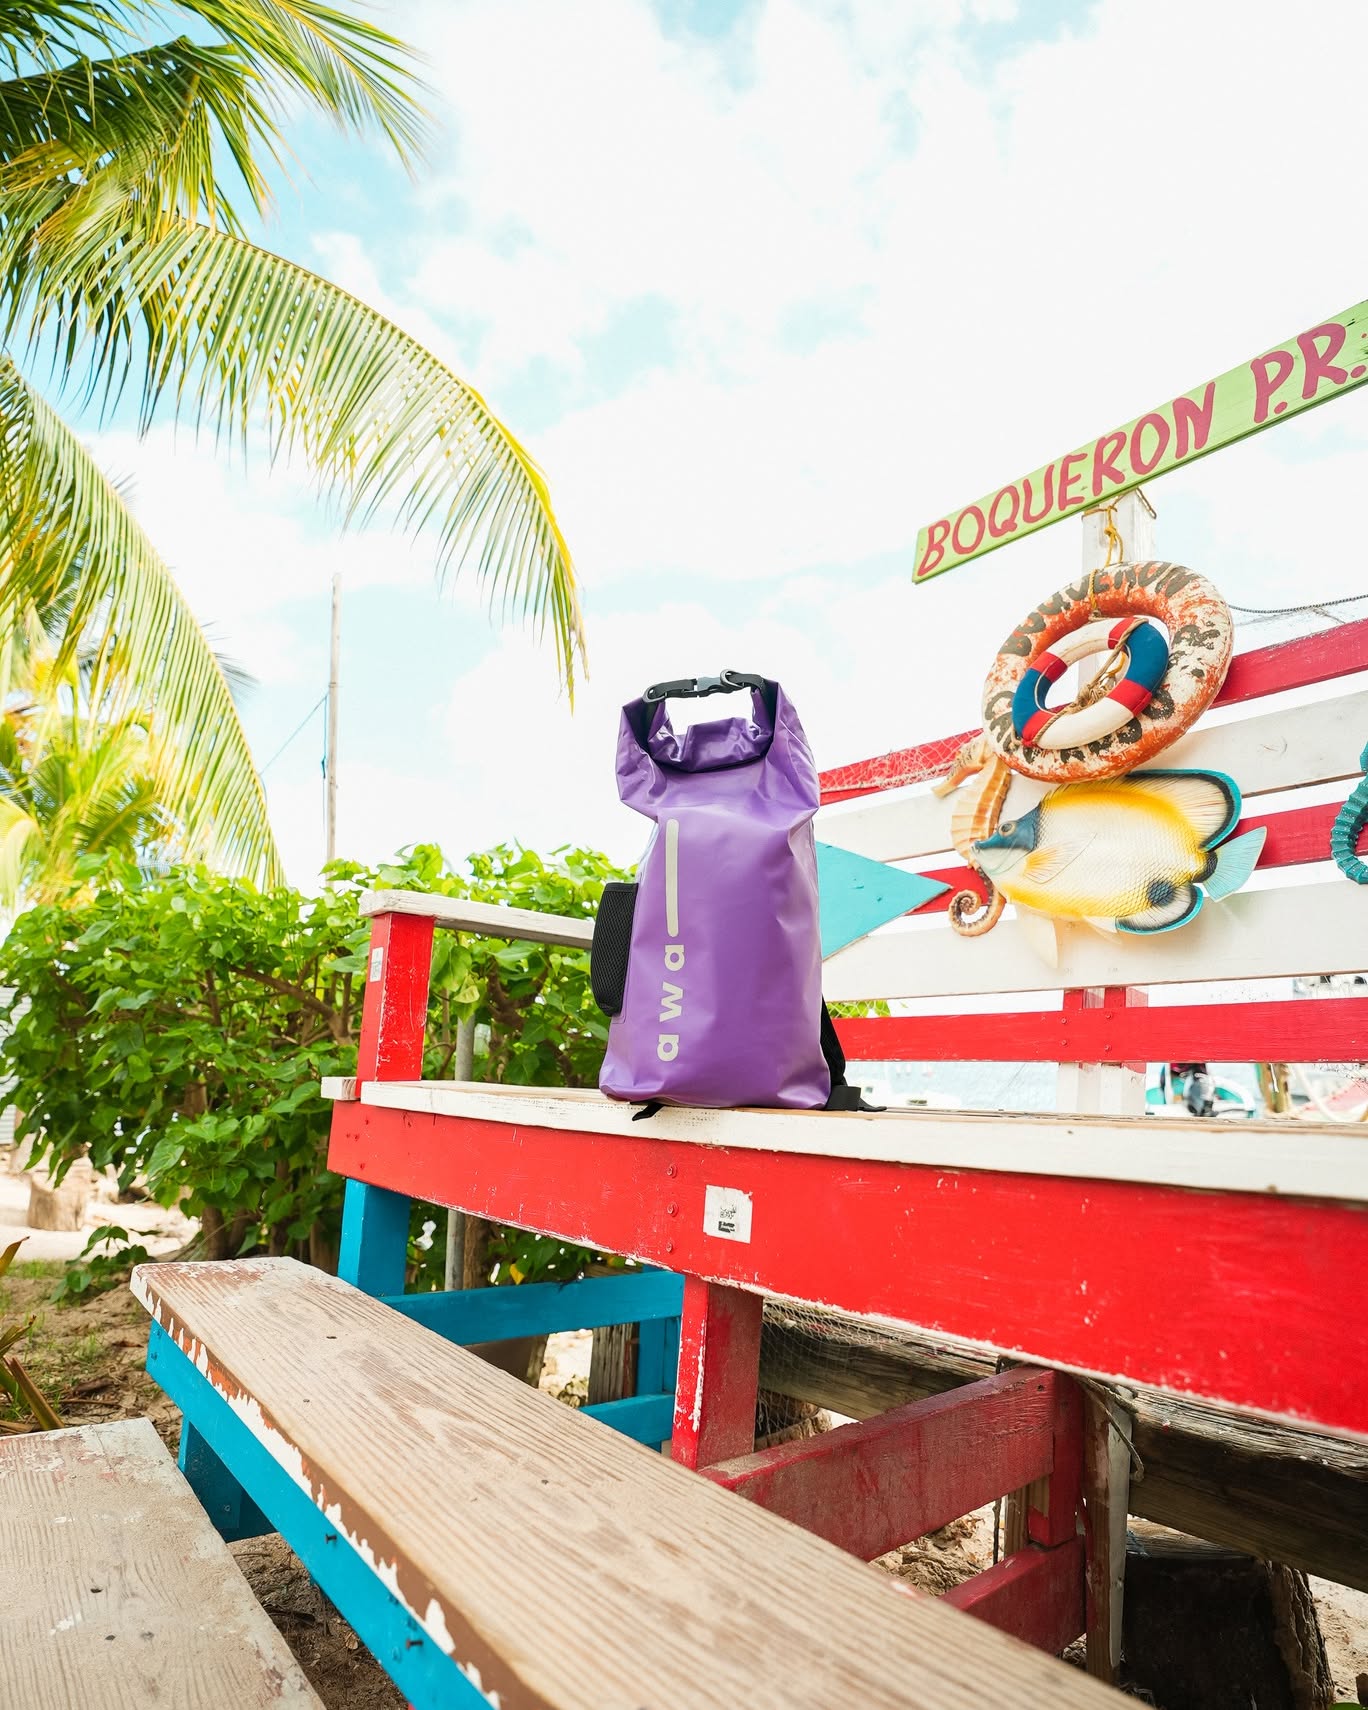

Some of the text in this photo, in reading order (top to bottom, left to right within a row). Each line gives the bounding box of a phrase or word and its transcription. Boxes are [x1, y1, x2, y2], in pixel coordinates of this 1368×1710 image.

[918, 322, 1367, 577] BOQUERON P.R.
[657, 944, 685, 1062] awa
